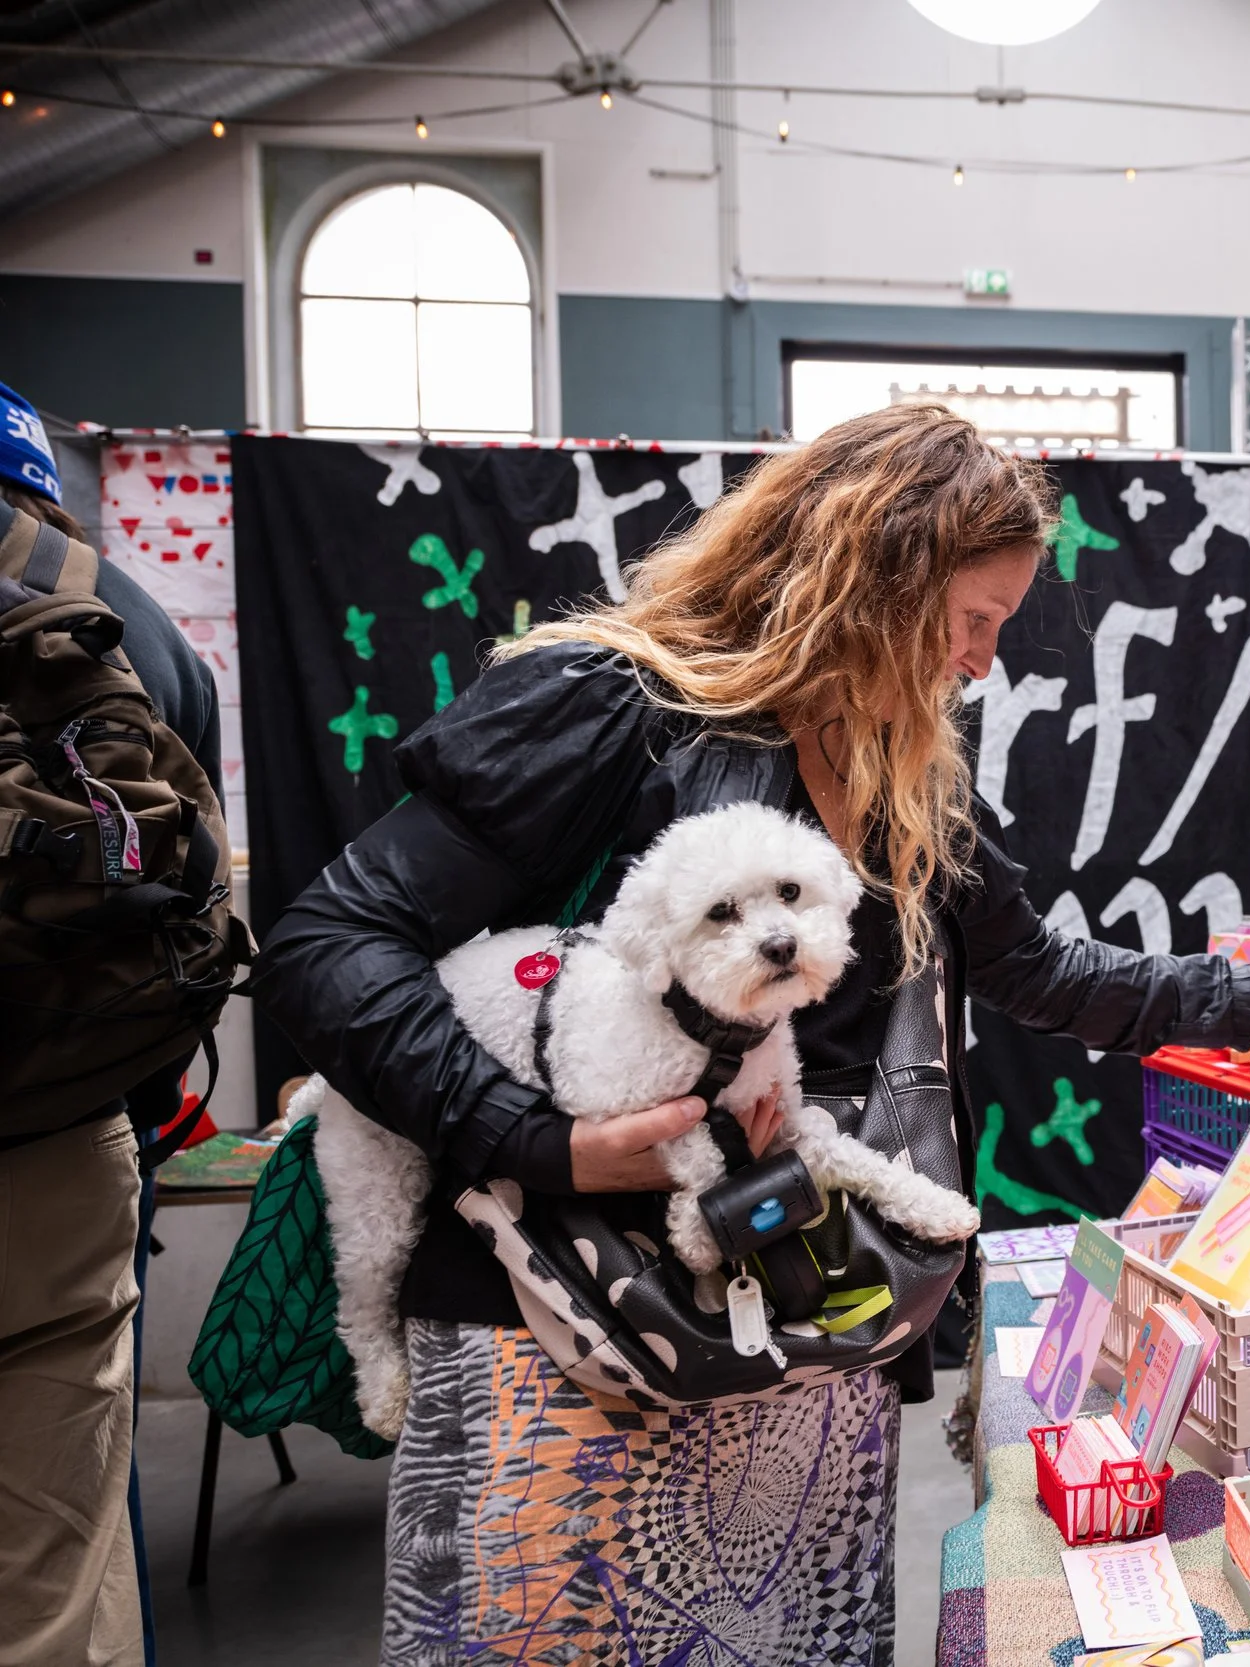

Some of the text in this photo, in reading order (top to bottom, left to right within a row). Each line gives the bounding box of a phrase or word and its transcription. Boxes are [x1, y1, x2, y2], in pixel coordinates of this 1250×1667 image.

[101, 816, 122, 881] WESURF
[1116, 1558, 1137, 1598] THROUGH
[1129, 1556, 1161, 1623] IT'S OK TO FLIP
